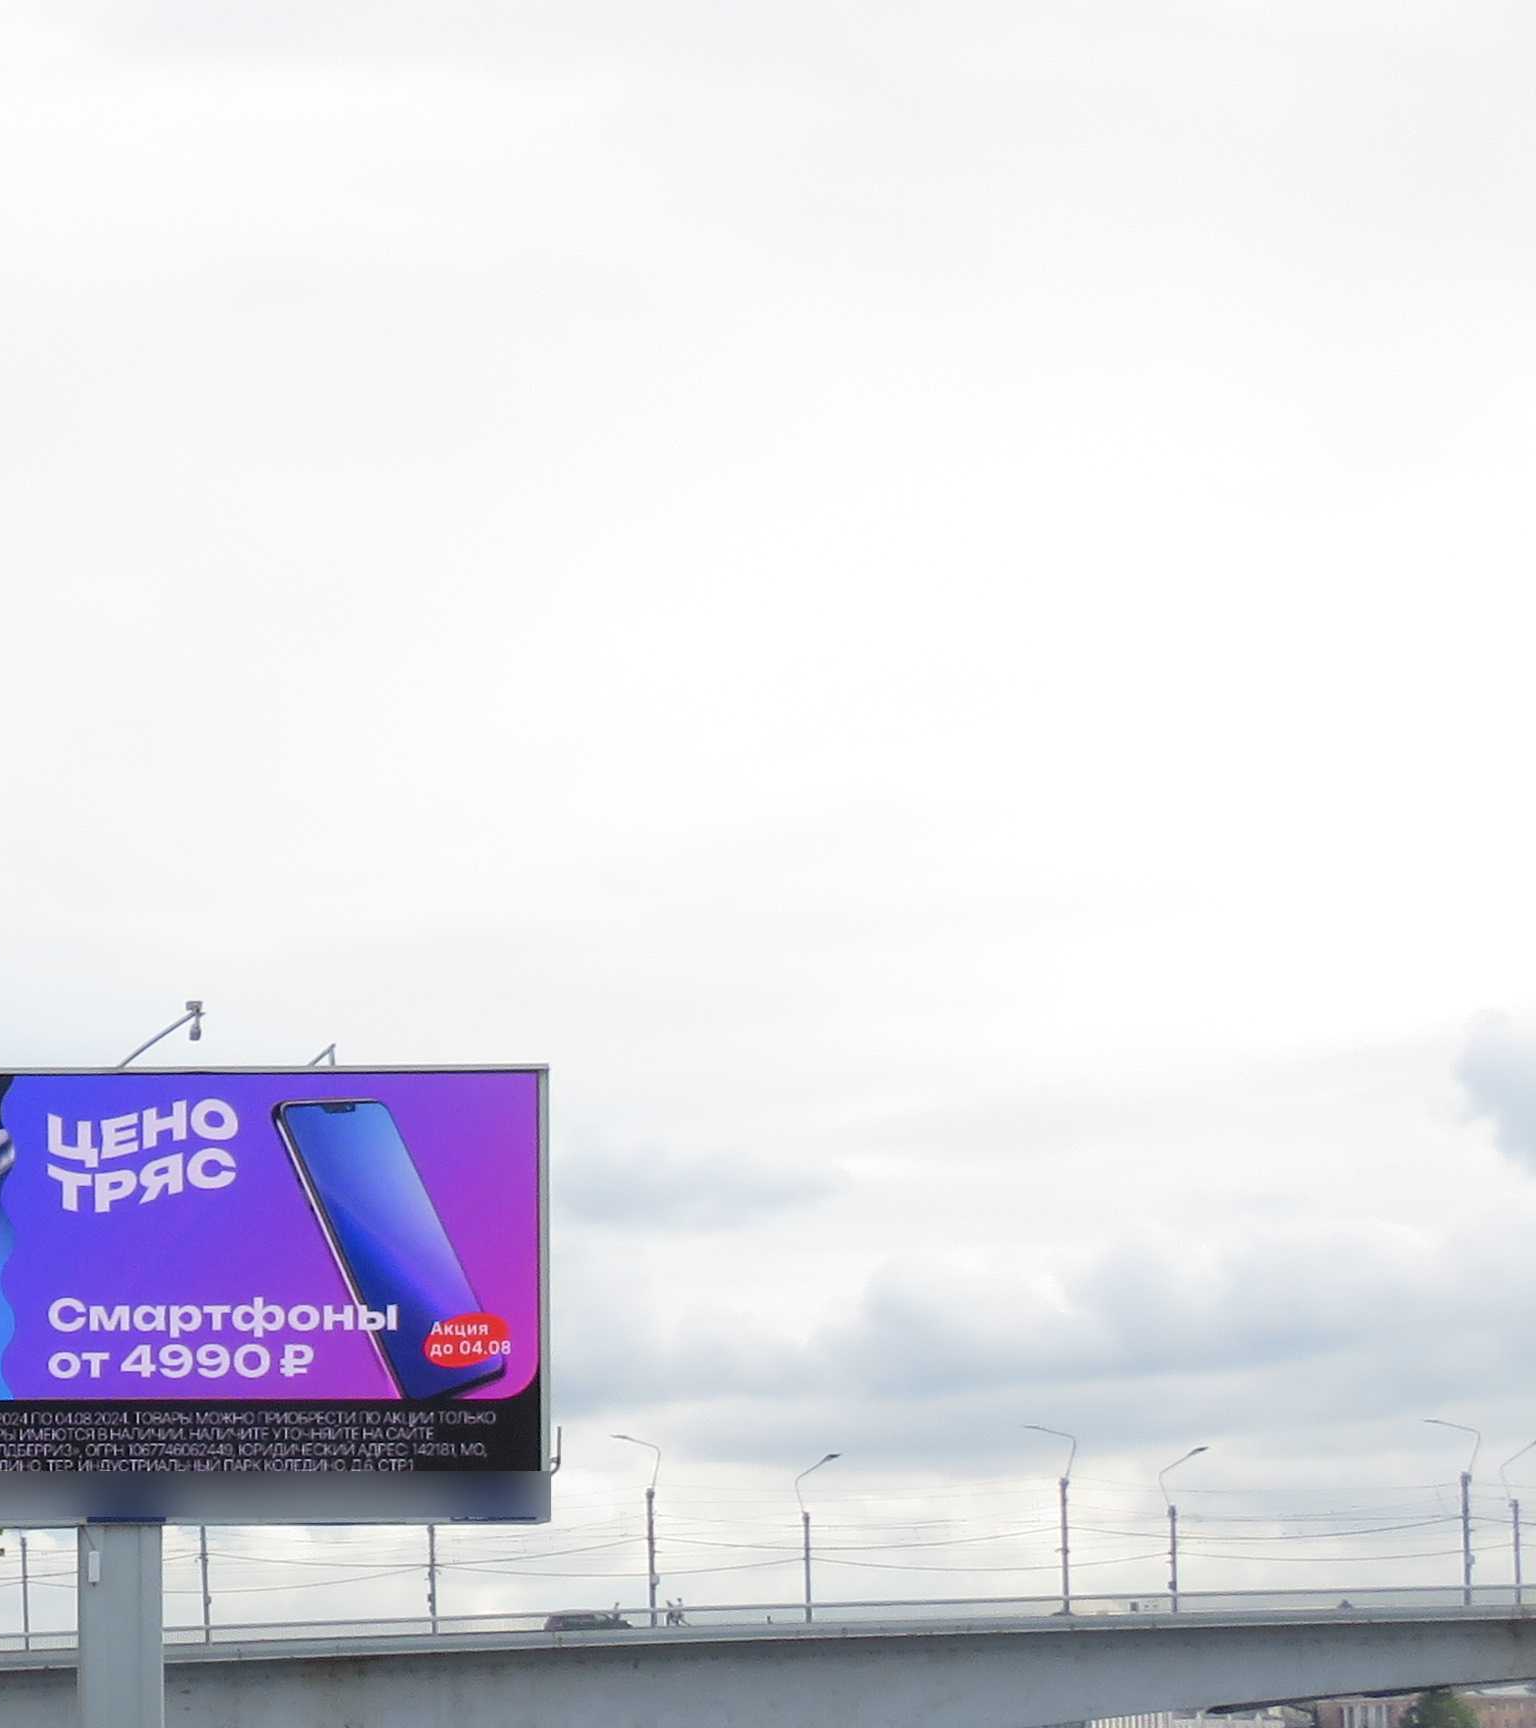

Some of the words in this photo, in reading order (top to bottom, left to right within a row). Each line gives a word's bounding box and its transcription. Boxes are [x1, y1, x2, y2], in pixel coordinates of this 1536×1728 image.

[47, 1098, 238, 1168] ЦЕНО
[47, 1147, 237, 1213] ТРЯС
[47, 1297, 398, 1337] Смартфоны
[431, 1321, 489, 1338] Акция
[430, 1344, 454, 1357] до
[459, 1340, 512, 1355] 04.08
[47, 1351, 110, 1378] от
[120, 1343, 271, 1378] 4990
[31, 1412, 53, 1425] ПО
[136, 1411, 191, 1424] ТОВАРЫ
[196, 1411, 255, 1424] МОЖНО
[258, 1411, 356, 1424] ПРИОБРЕСТИ
[360, 1411, 380, 1424] ПО
[384, 1411, 434, 1426] АКЦИИ
[438, 1411, 496, 1424] ТОЛЬКО
[20, 1428, 95, 1441] ИМЕЮТСЯ
[98, 1428, 108, 1441] В
[363, 1427, 383, 1440] НА
[85, 1444, 123, 1457] ОГРН
[224, 1459, 262, 1471] ПАРК
